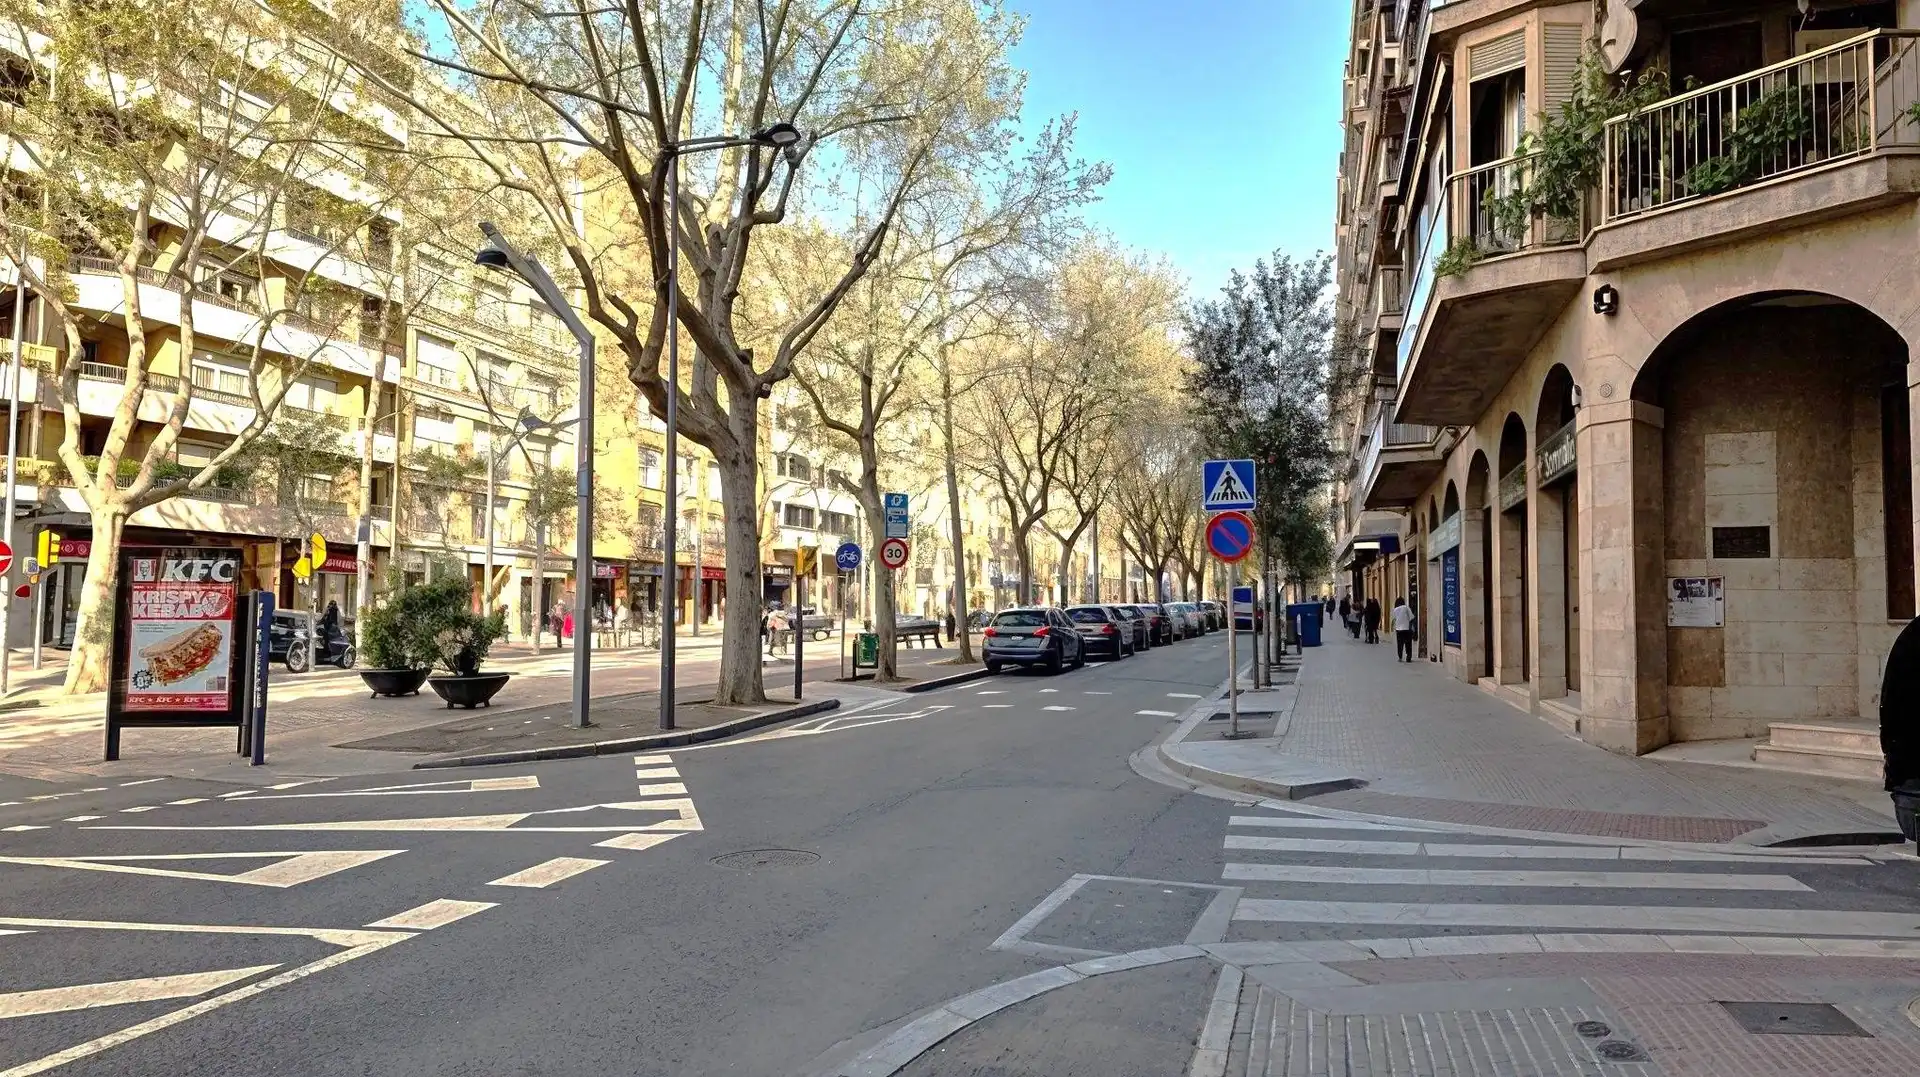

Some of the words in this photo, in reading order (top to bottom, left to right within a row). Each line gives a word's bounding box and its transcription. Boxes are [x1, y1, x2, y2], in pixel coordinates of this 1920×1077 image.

[887, 548, 902, 558] 30
[161, 559, 236, 582] KFC
[132, 591, 206, 604] KRISPY
[132, 604, 204, 618] KEBAB
